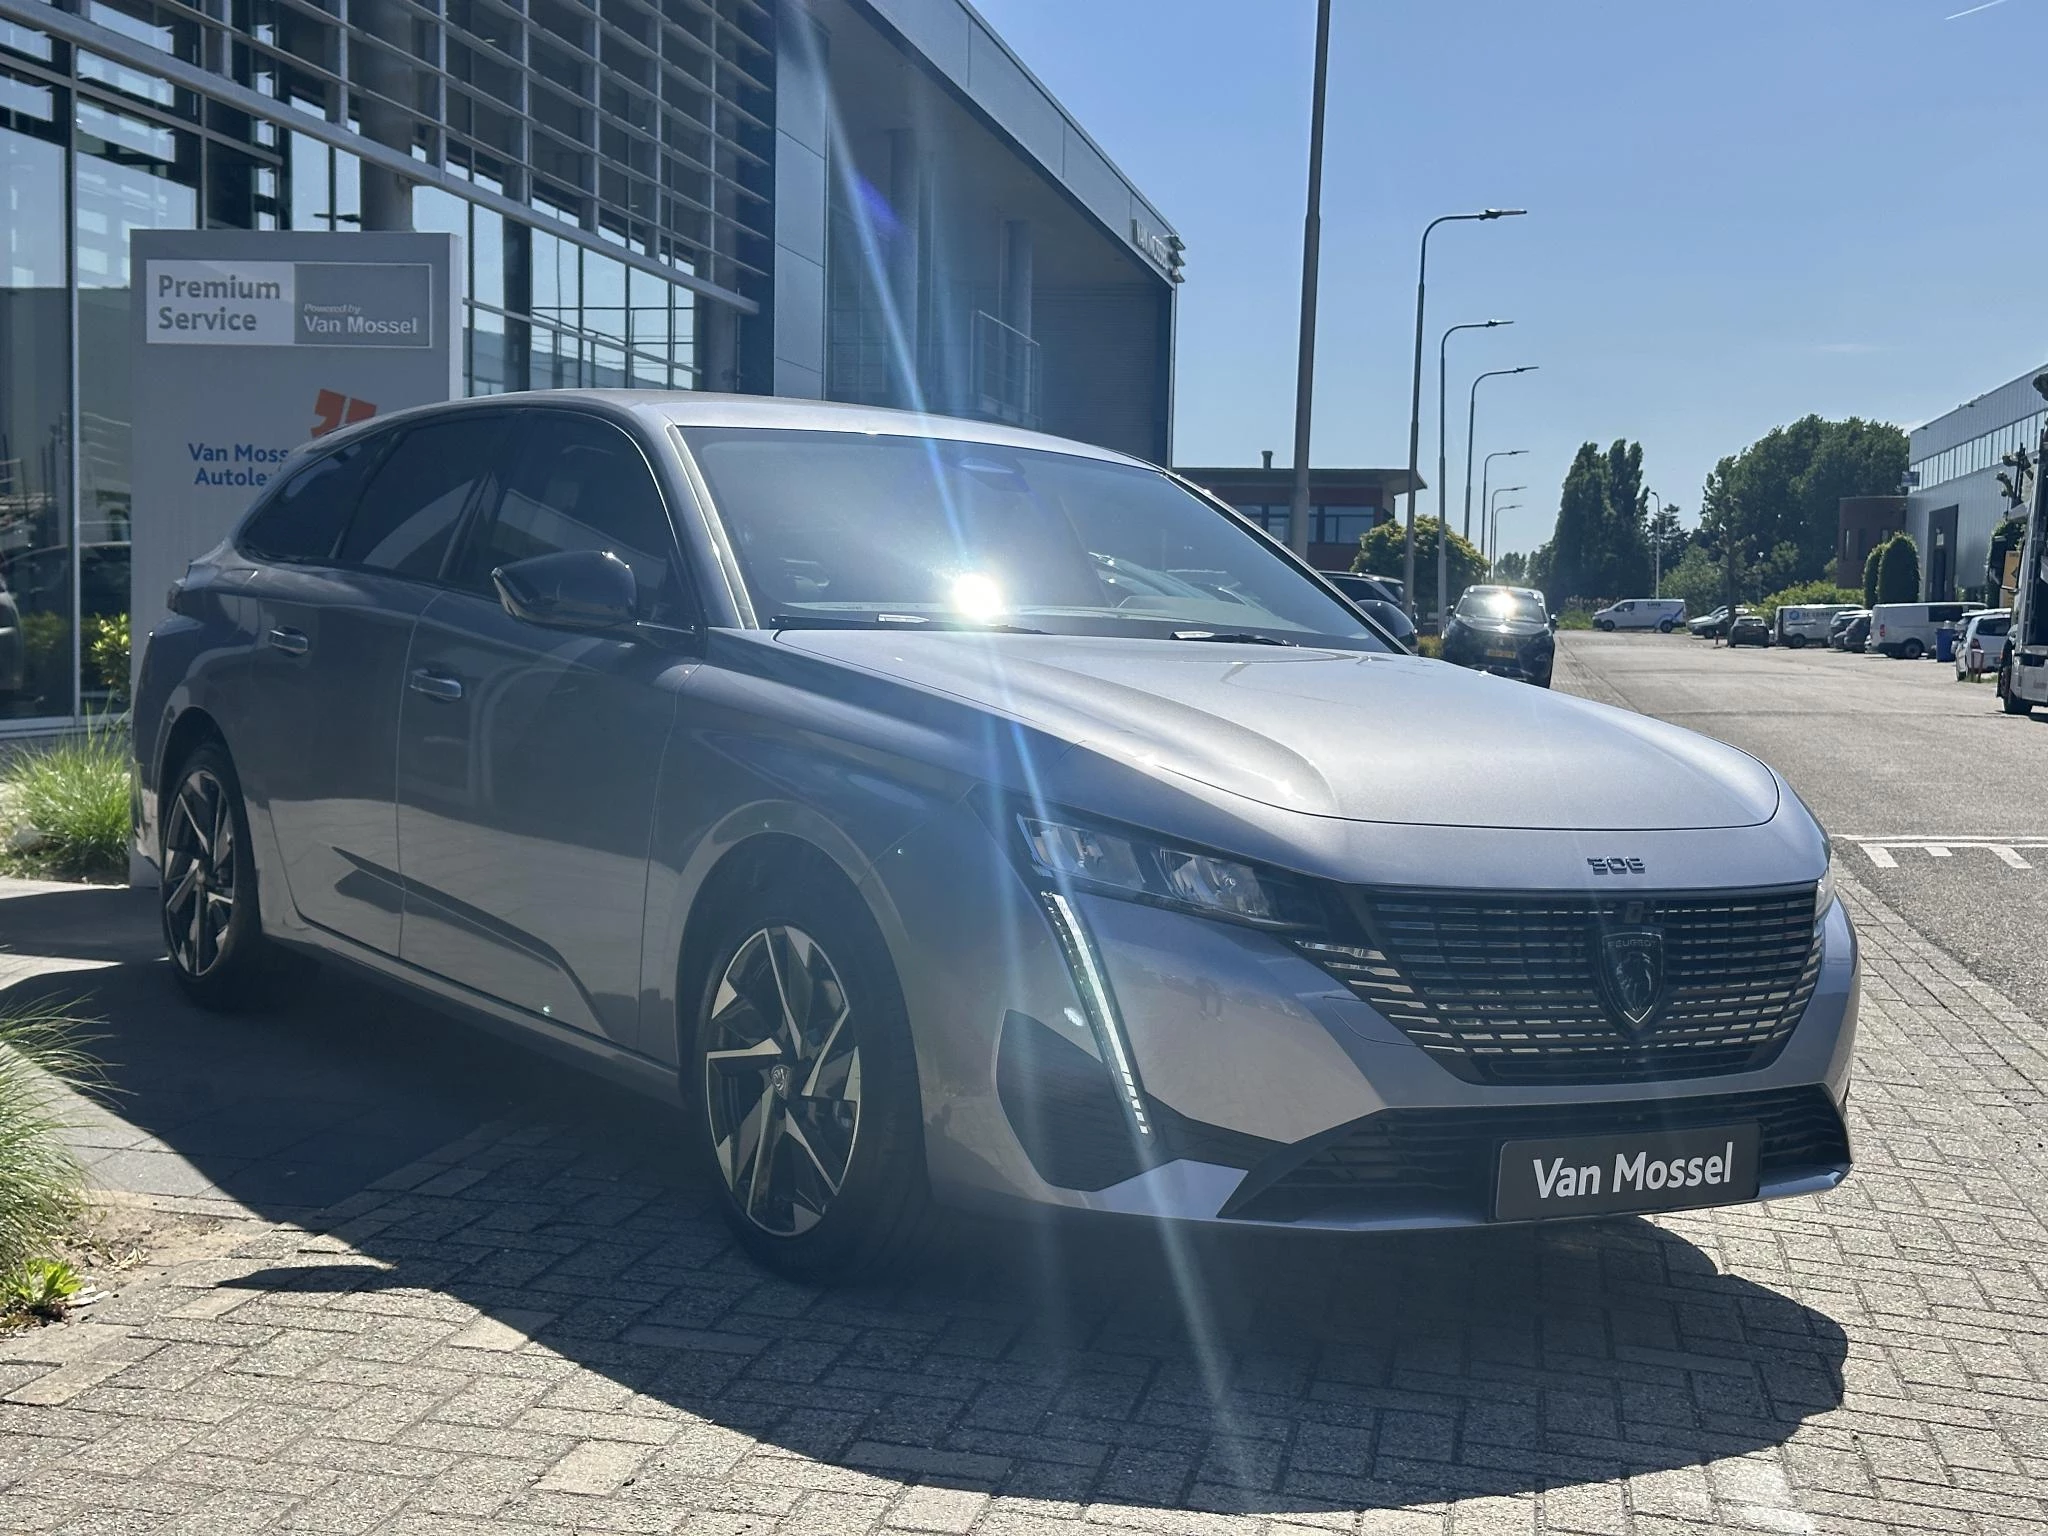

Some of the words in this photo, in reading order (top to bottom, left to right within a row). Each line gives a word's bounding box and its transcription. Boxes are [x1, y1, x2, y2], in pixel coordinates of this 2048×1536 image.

[158, 275, 280, 299] Premium
[304, 303, 347, 313] Powered
[348, 303, 361, 315] by
[158, 307, 257, 331] Service
[304, 315, 341, 333] Van
[347, 316, 417, 334] Mossel
[188, 443, 228, 462] Van
[194, 467, 272, 486] Autole
[1533, 1157, 1601, 1199] Van
[1612, 1141, 1734, 1193] Mossel
